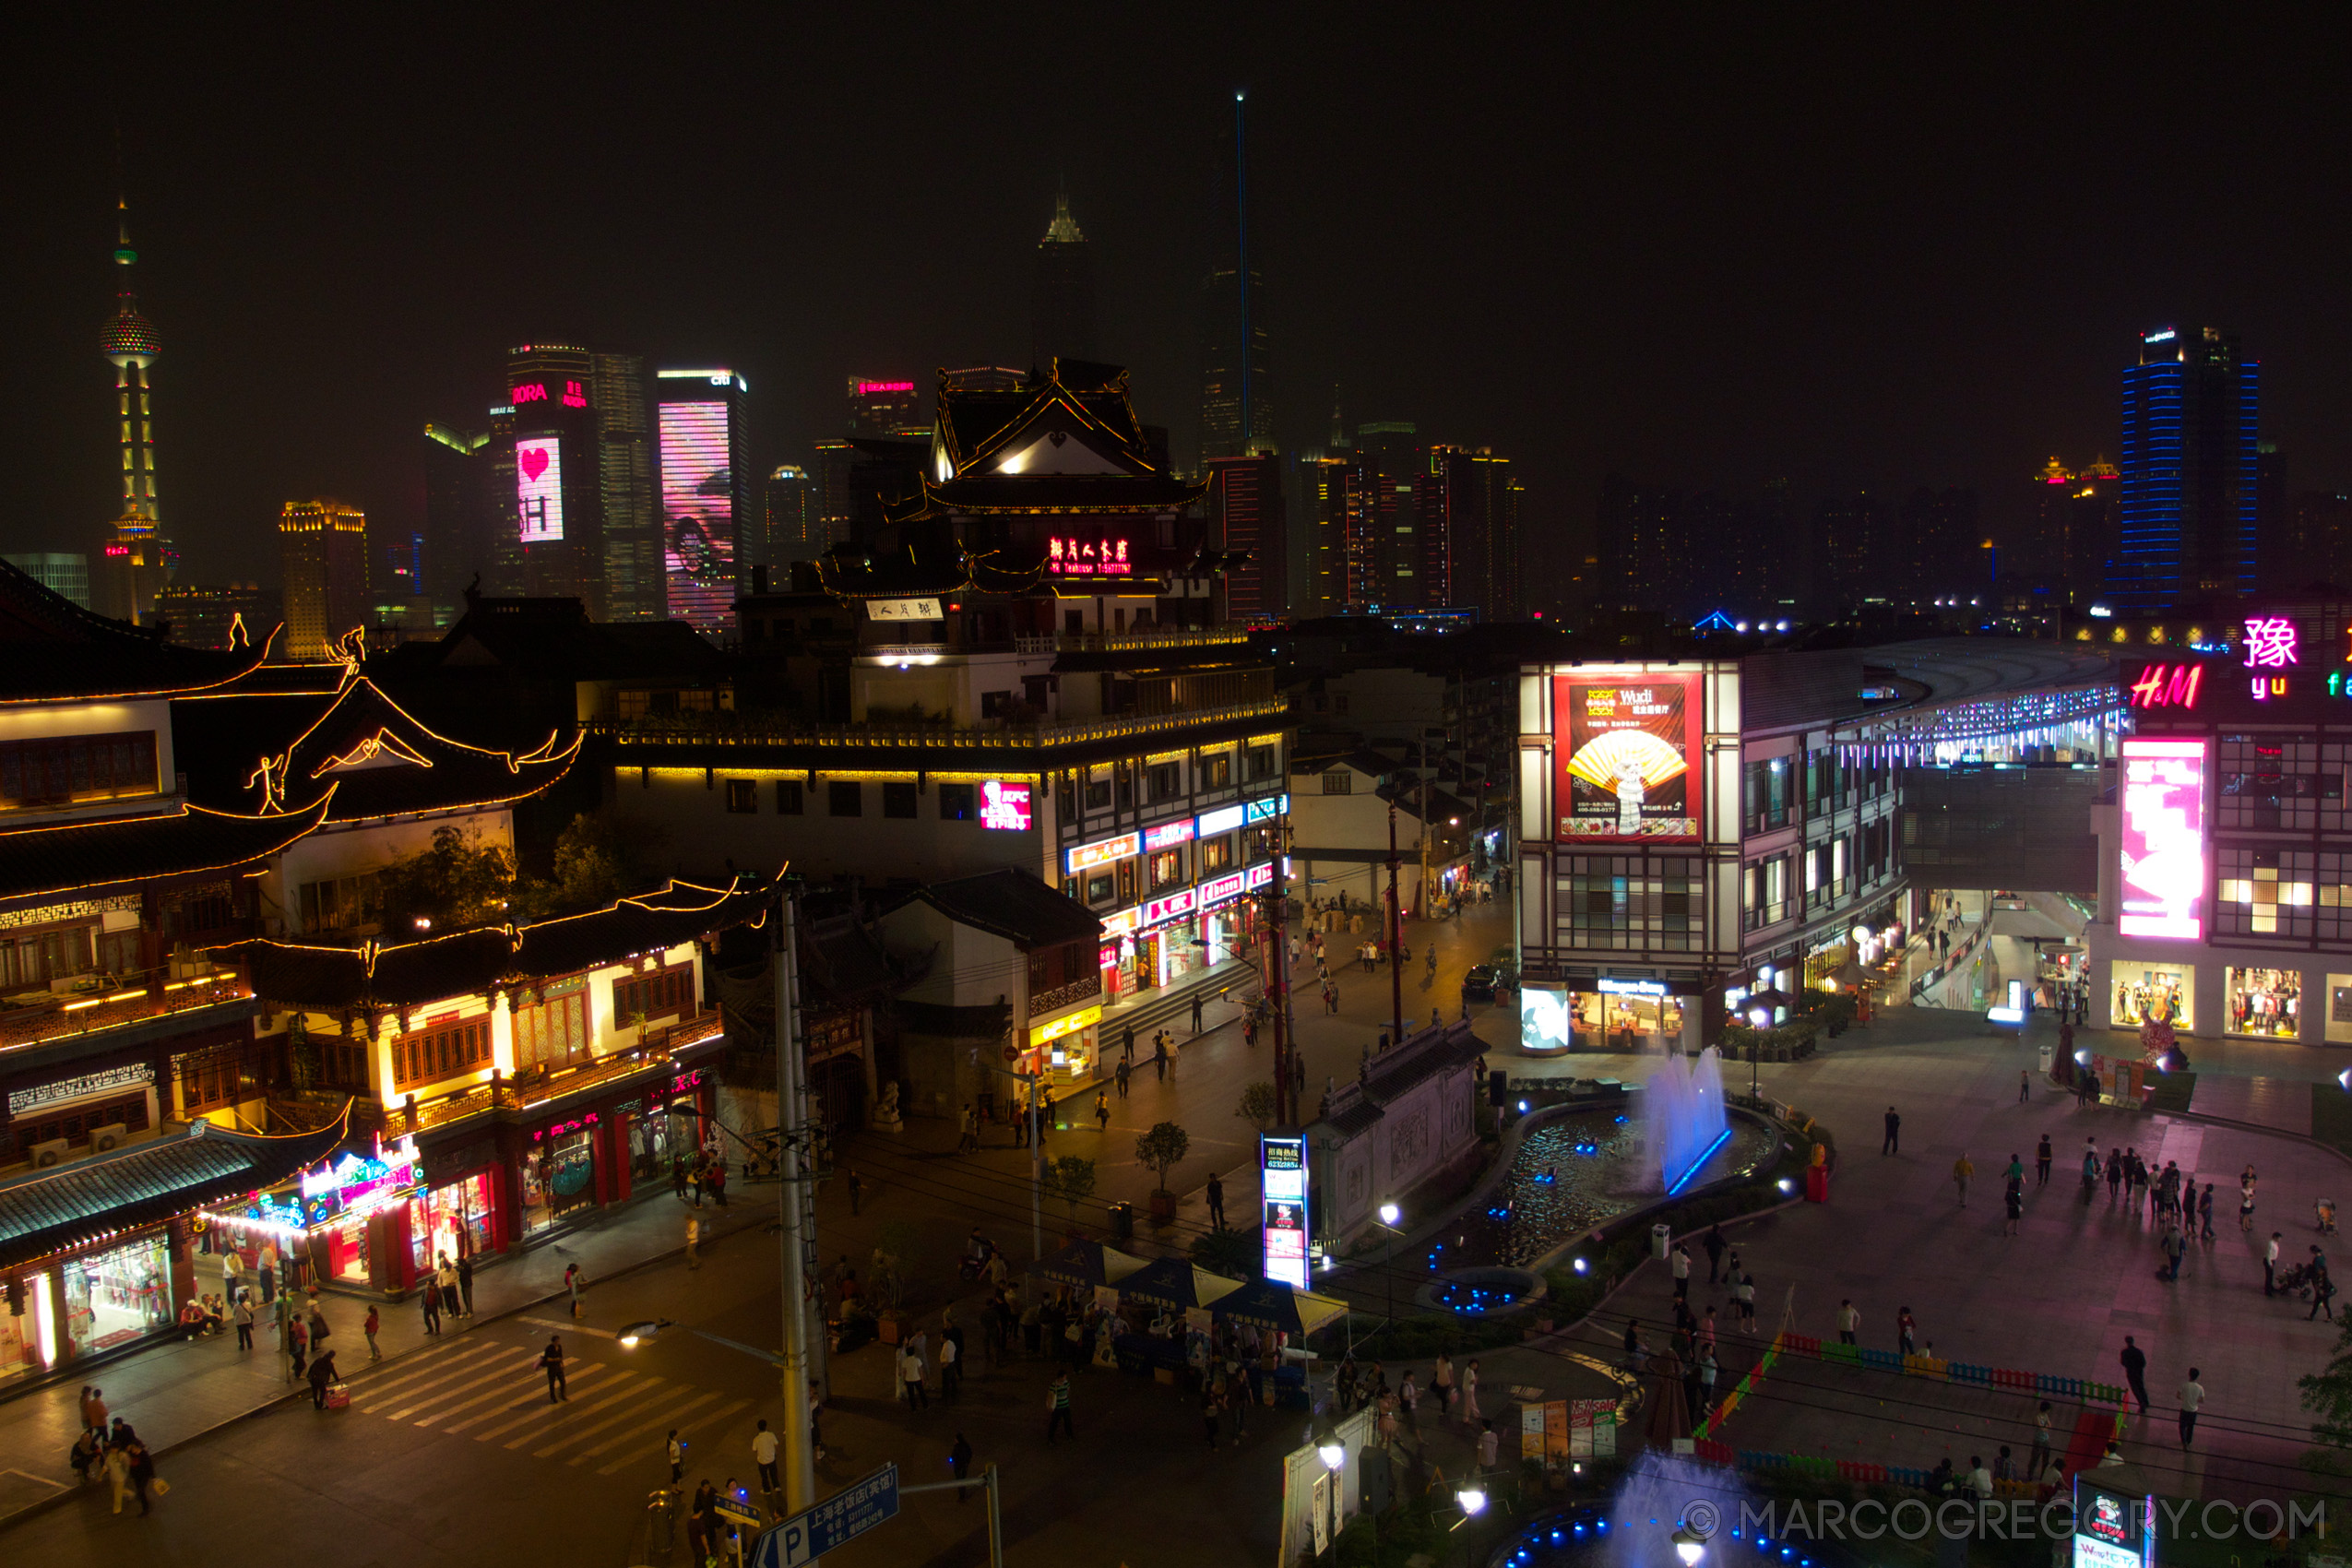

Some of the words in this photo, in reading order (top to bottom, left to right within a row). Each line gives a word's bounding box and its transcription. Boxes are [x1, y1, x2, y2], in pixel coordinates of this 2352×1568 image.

[711, 374, 731, 386] citi
[2242, 618, 2297, 667] 豫
[2130, 663, 2202, 708] H&M
[2251, 677, 2285, 700] yu
[1620, 689, 1652, 703] Wudi
[1002, 790, 1029, 802] KFC
[1170, 896, 1187, 912] KFC
[1593, 1399, 1616, 1412] SALE
[786, 1526, 801, 1565] P
